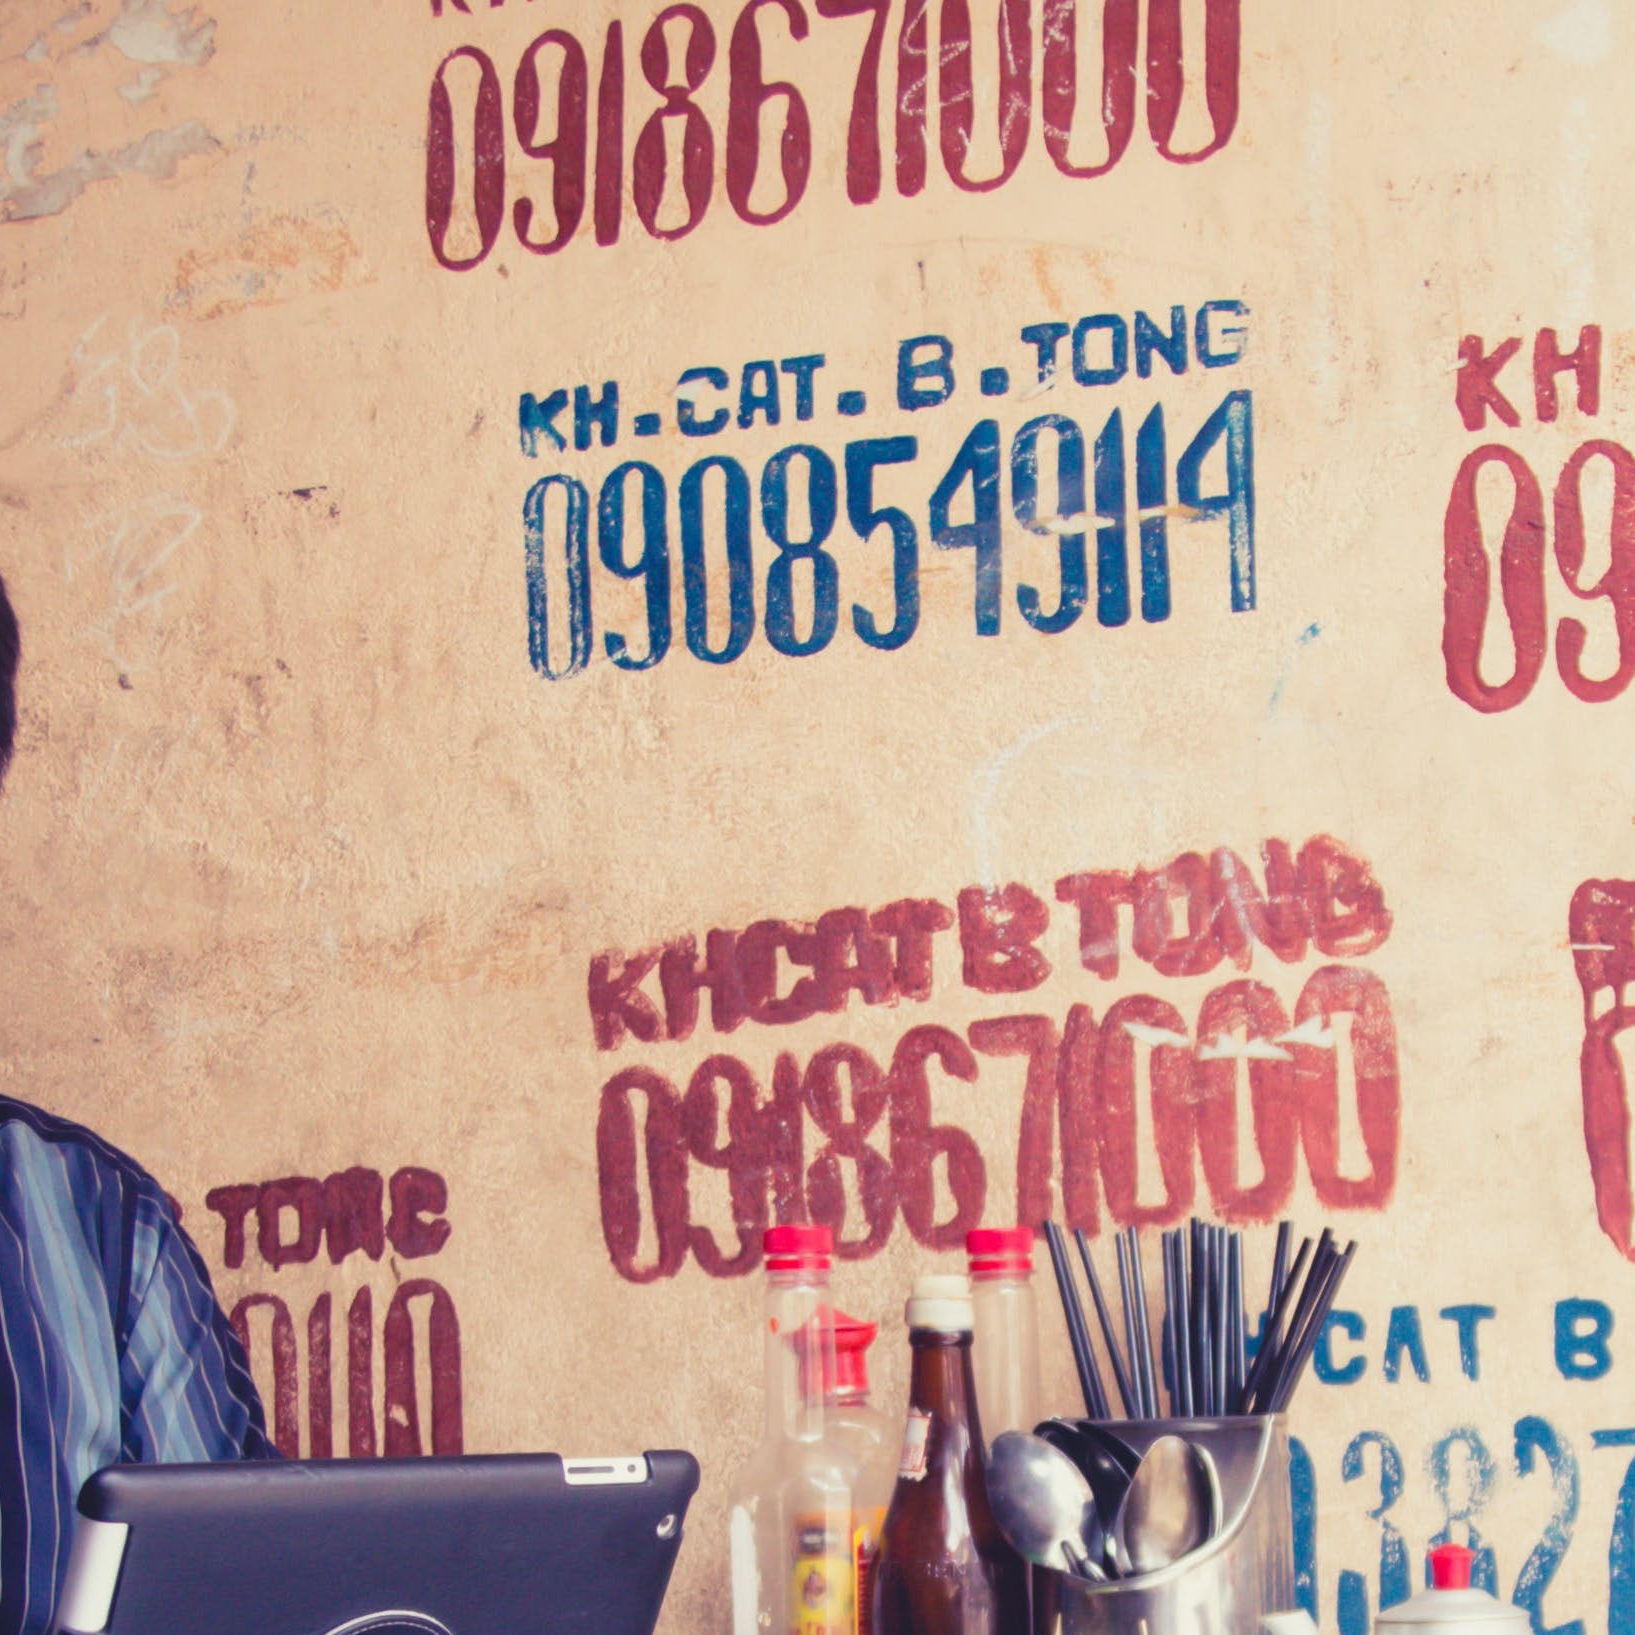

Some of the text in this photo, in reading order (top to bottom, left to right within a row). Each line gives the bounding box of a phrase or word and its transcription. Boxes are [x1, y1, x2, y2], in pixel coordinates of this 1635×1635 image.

[426, 0, 1242, 271] 0918671000
[1454, 323, 1601, 431] KH
[522, 390, 1256, 681] 0908549114
[596, 964, 1403, 1284] 0918671000
[1313, 1303, 1497, 1386] CAT
[1554, 1297, 1615, 1381] B
